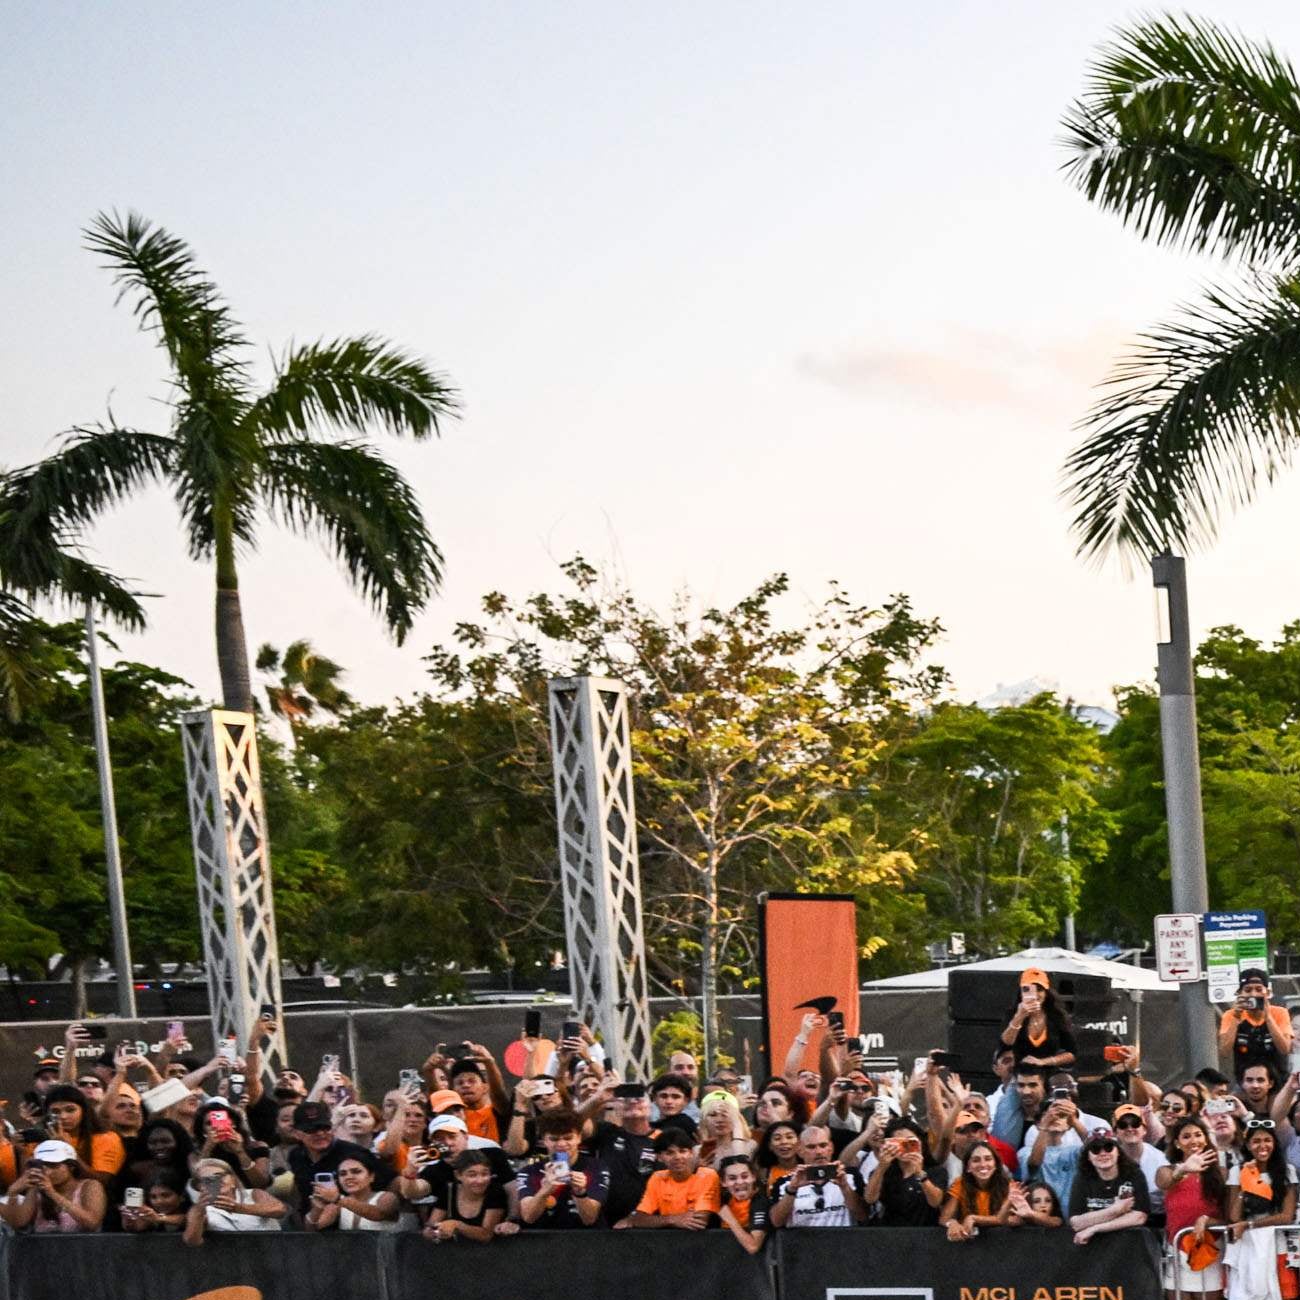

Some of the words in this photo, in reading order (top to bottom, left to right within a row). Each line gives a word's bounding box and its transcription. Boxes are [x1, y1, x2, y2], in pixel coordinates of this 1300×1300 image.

[1159, 930, 1195, 939] PARKING
[1169, 940, 1185, 950] ANY
[52, 1044, 105, 1058] Gmini
